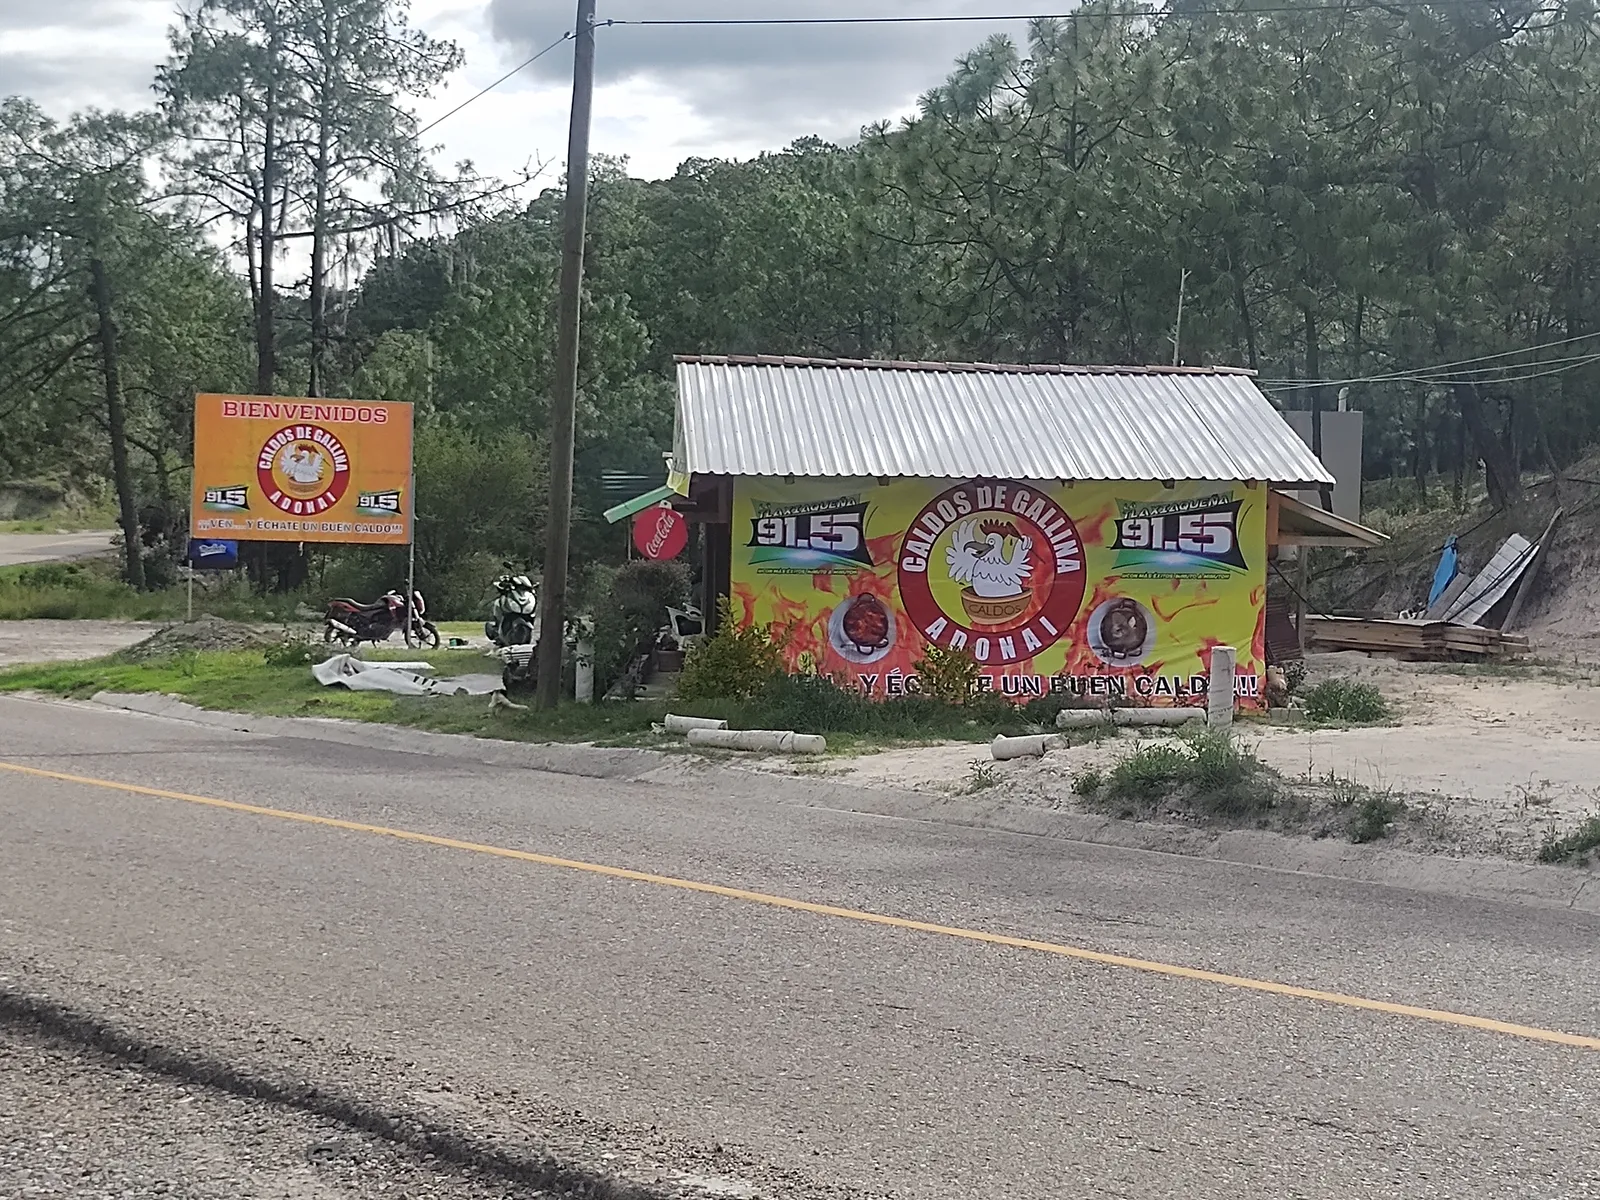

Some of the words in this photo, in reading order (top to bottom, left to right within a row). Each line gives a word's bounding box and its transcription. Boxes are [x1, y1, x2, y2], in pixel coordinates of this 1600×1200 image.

[223, 401, 389, 424] BIENVENIDOS
[259, 428, 294, 470] CALDOS
[296, 426, 312, 440] DE
[313, 429, 348, 472] GALLINA
[206, 489, 246, 506] 91.5
[269, 490, 337, 514] ADONAI
[359, 494, 399, 510] 91.5
[256, 516, 300, 531] ÉCHATE
[302, 522, 318, 532] UN
[321, 522, 352, 533] BUEN
[757, 512, 860, 552] 91.5
[902, 491, 972, 573] CALDOS
[976, 485, 1008, 510] DE
[1011, 489, 1081, 574] GALLINA
[1121, 511, 1234, 554] 91.5
[969, 604, 1022, 616] CALDOS
[925, 616, 1059, 661] ADONAI
[858, 674, 879, 695] Y
[1000, 675, 1041, 696] UN
[1049, 675, 1127, 696] BUEN
[1134, 675, 1258, 697] CALD!!!
